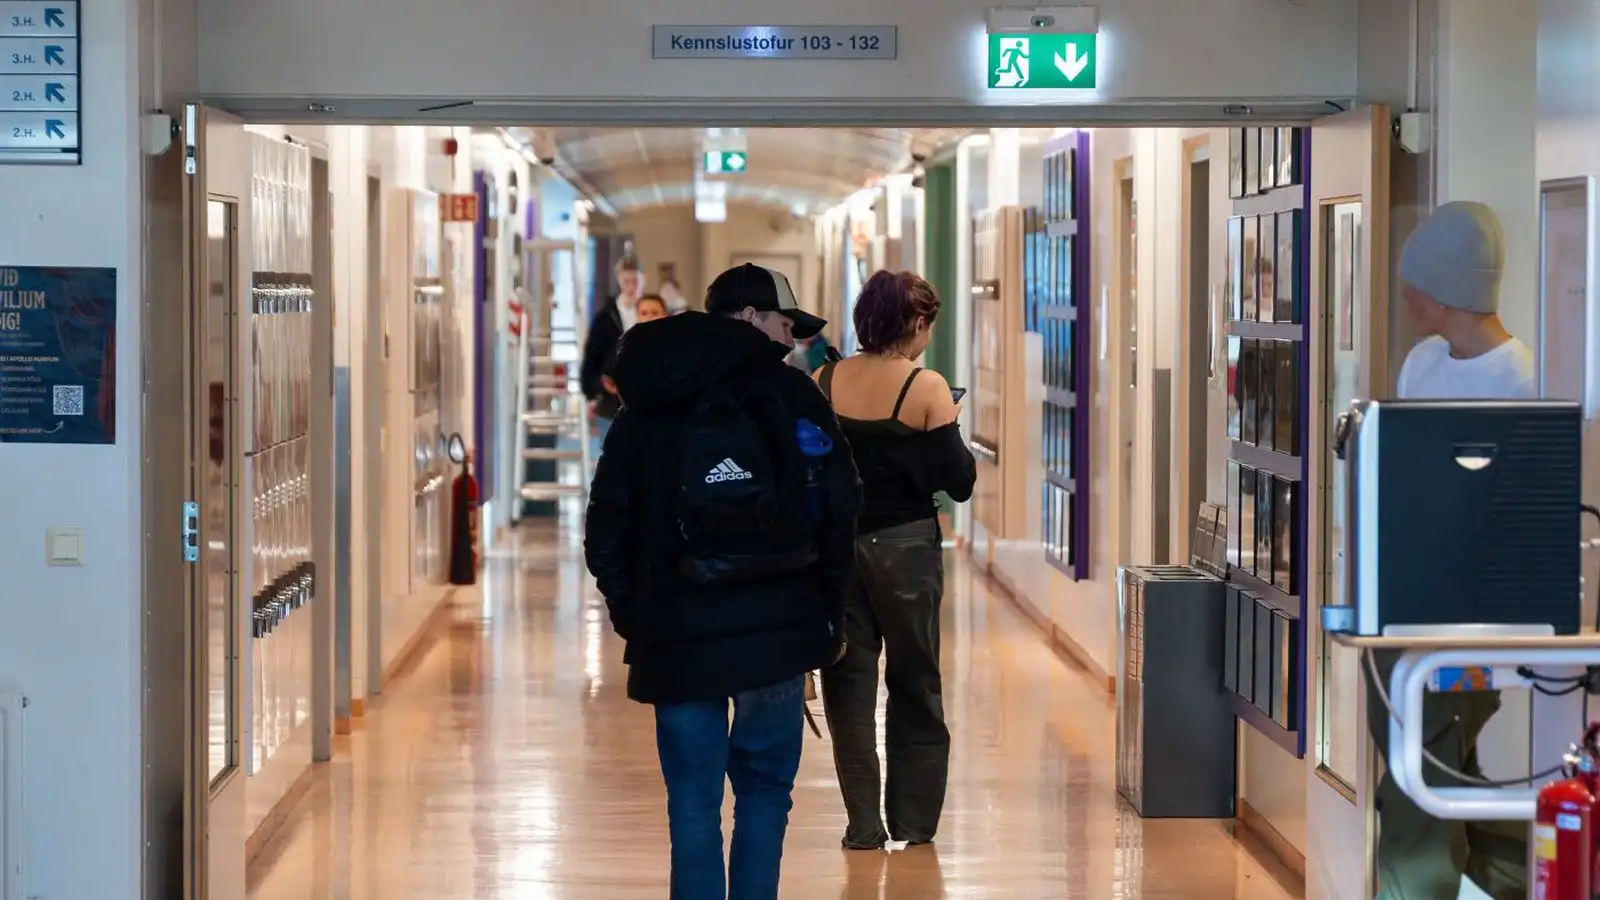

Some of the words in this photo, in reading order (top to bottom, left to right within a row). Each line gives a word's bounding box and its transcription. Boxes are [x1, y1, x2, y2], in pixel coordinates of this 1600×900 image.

[12, 16, 36, 27] 3.H.
[671, 34, 794, 50] Kennslustofur
[800, 35, 831, 50] 103
[848, 35, 880, 50] 132
[12, 54, 36, 64] 3.H.
[12, 91, 36, 101] 2.H.
[12, 127, 36, 138] 2.H.
[0, 312, 20, 330] IG!
[705, 471, 752, 483] adidas
